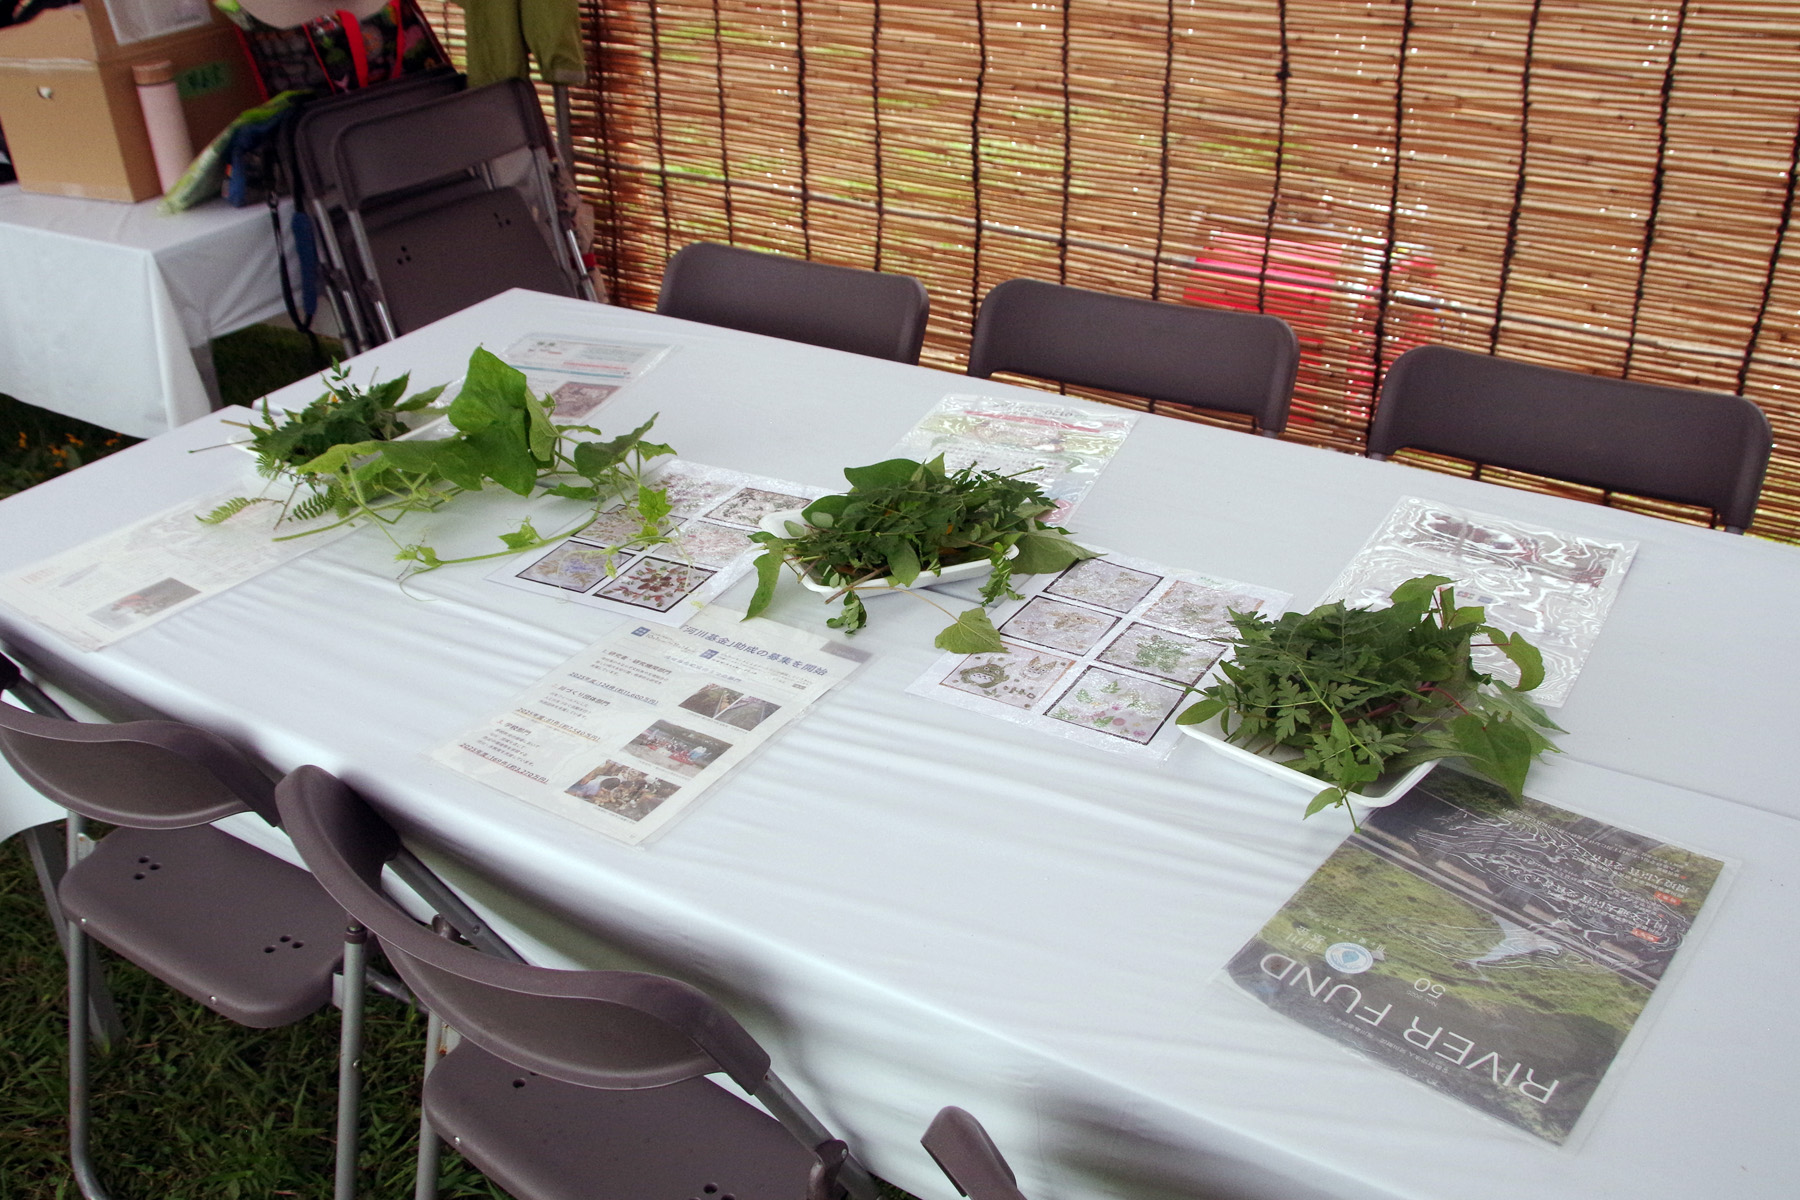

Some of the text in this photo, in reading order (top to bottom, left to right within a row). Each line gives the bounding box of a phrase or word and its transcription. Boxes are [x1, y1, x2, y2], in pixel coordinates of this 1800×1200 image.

[1259, 951, 1560, 1106] RIVER FUND
[1413, 976, 1447, 1000] 50
